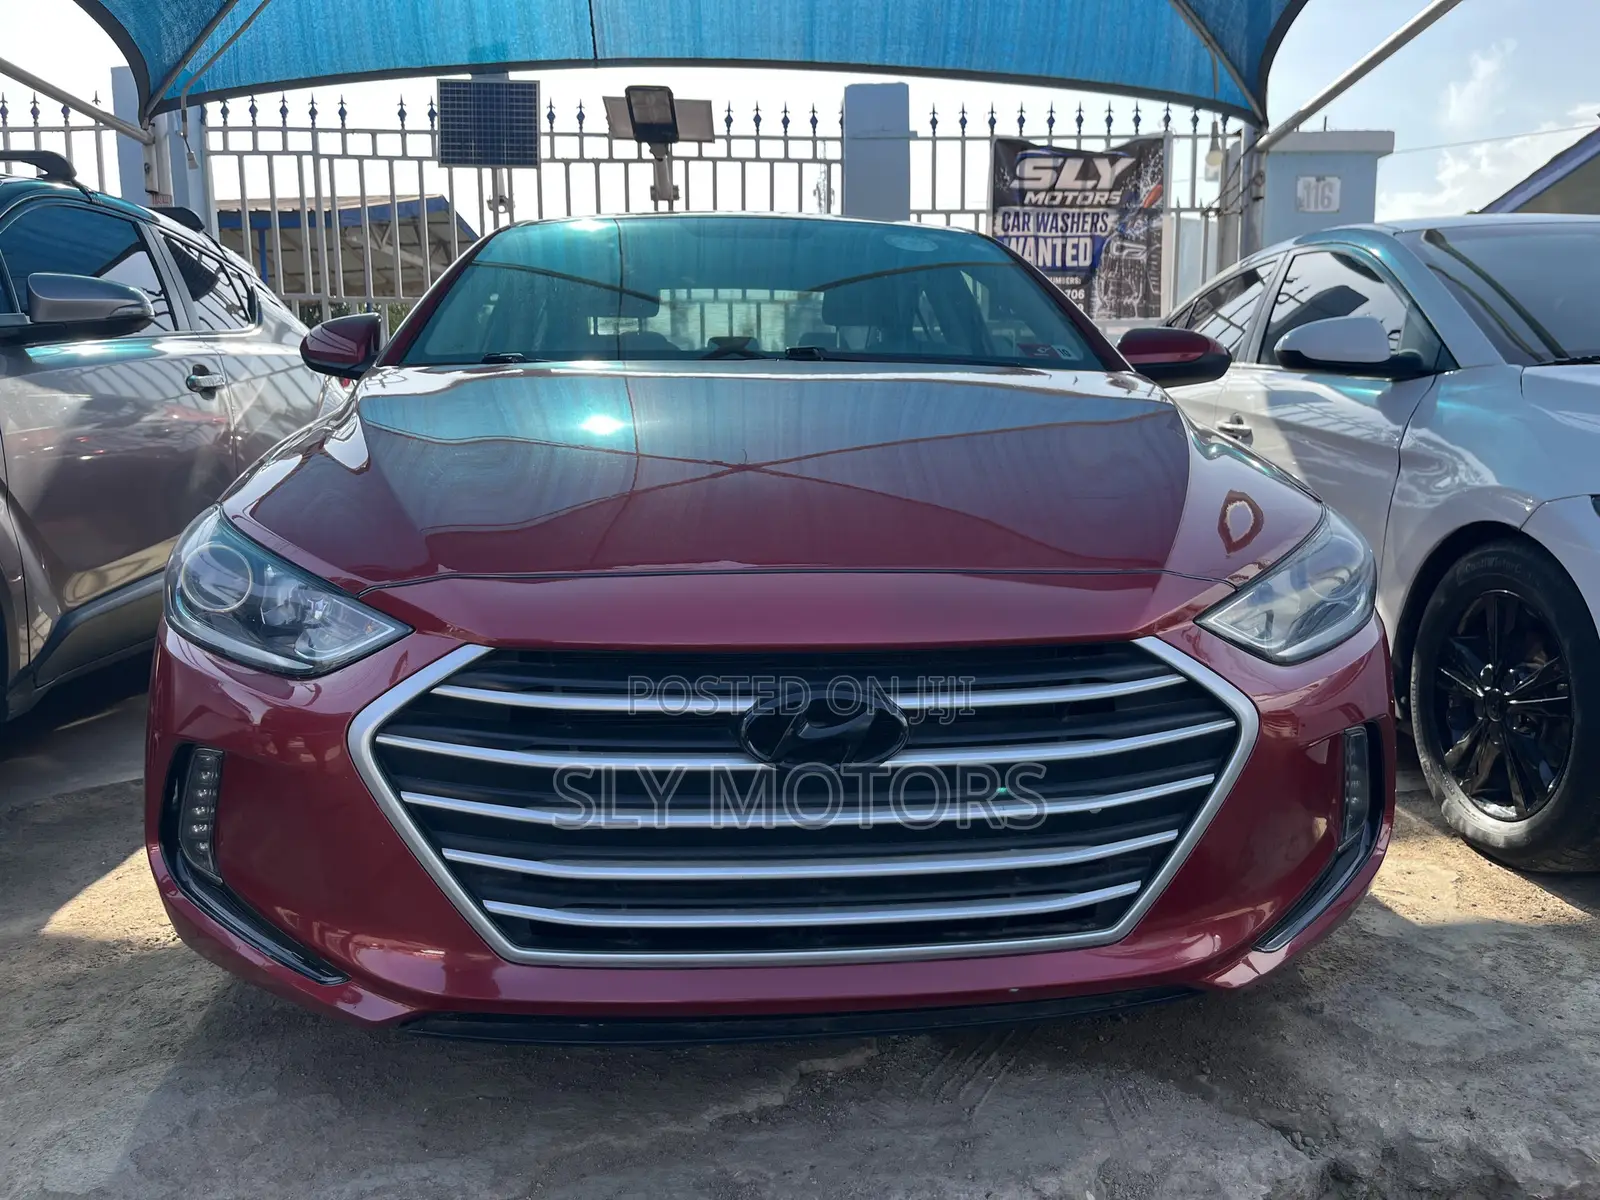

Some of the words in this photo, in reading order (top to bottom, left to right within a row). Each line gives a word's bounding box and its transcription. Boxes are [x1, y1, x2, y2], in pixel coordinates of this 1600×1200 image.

[1010, 158, 1136, 190] SLY
[1024, 190, 1123, 205] MOTORS
[1304, 181, 1334, 209] 116
[1001, 210, 1032, 232] CAR
[1035, 211, 1109, 233] WASHERS
